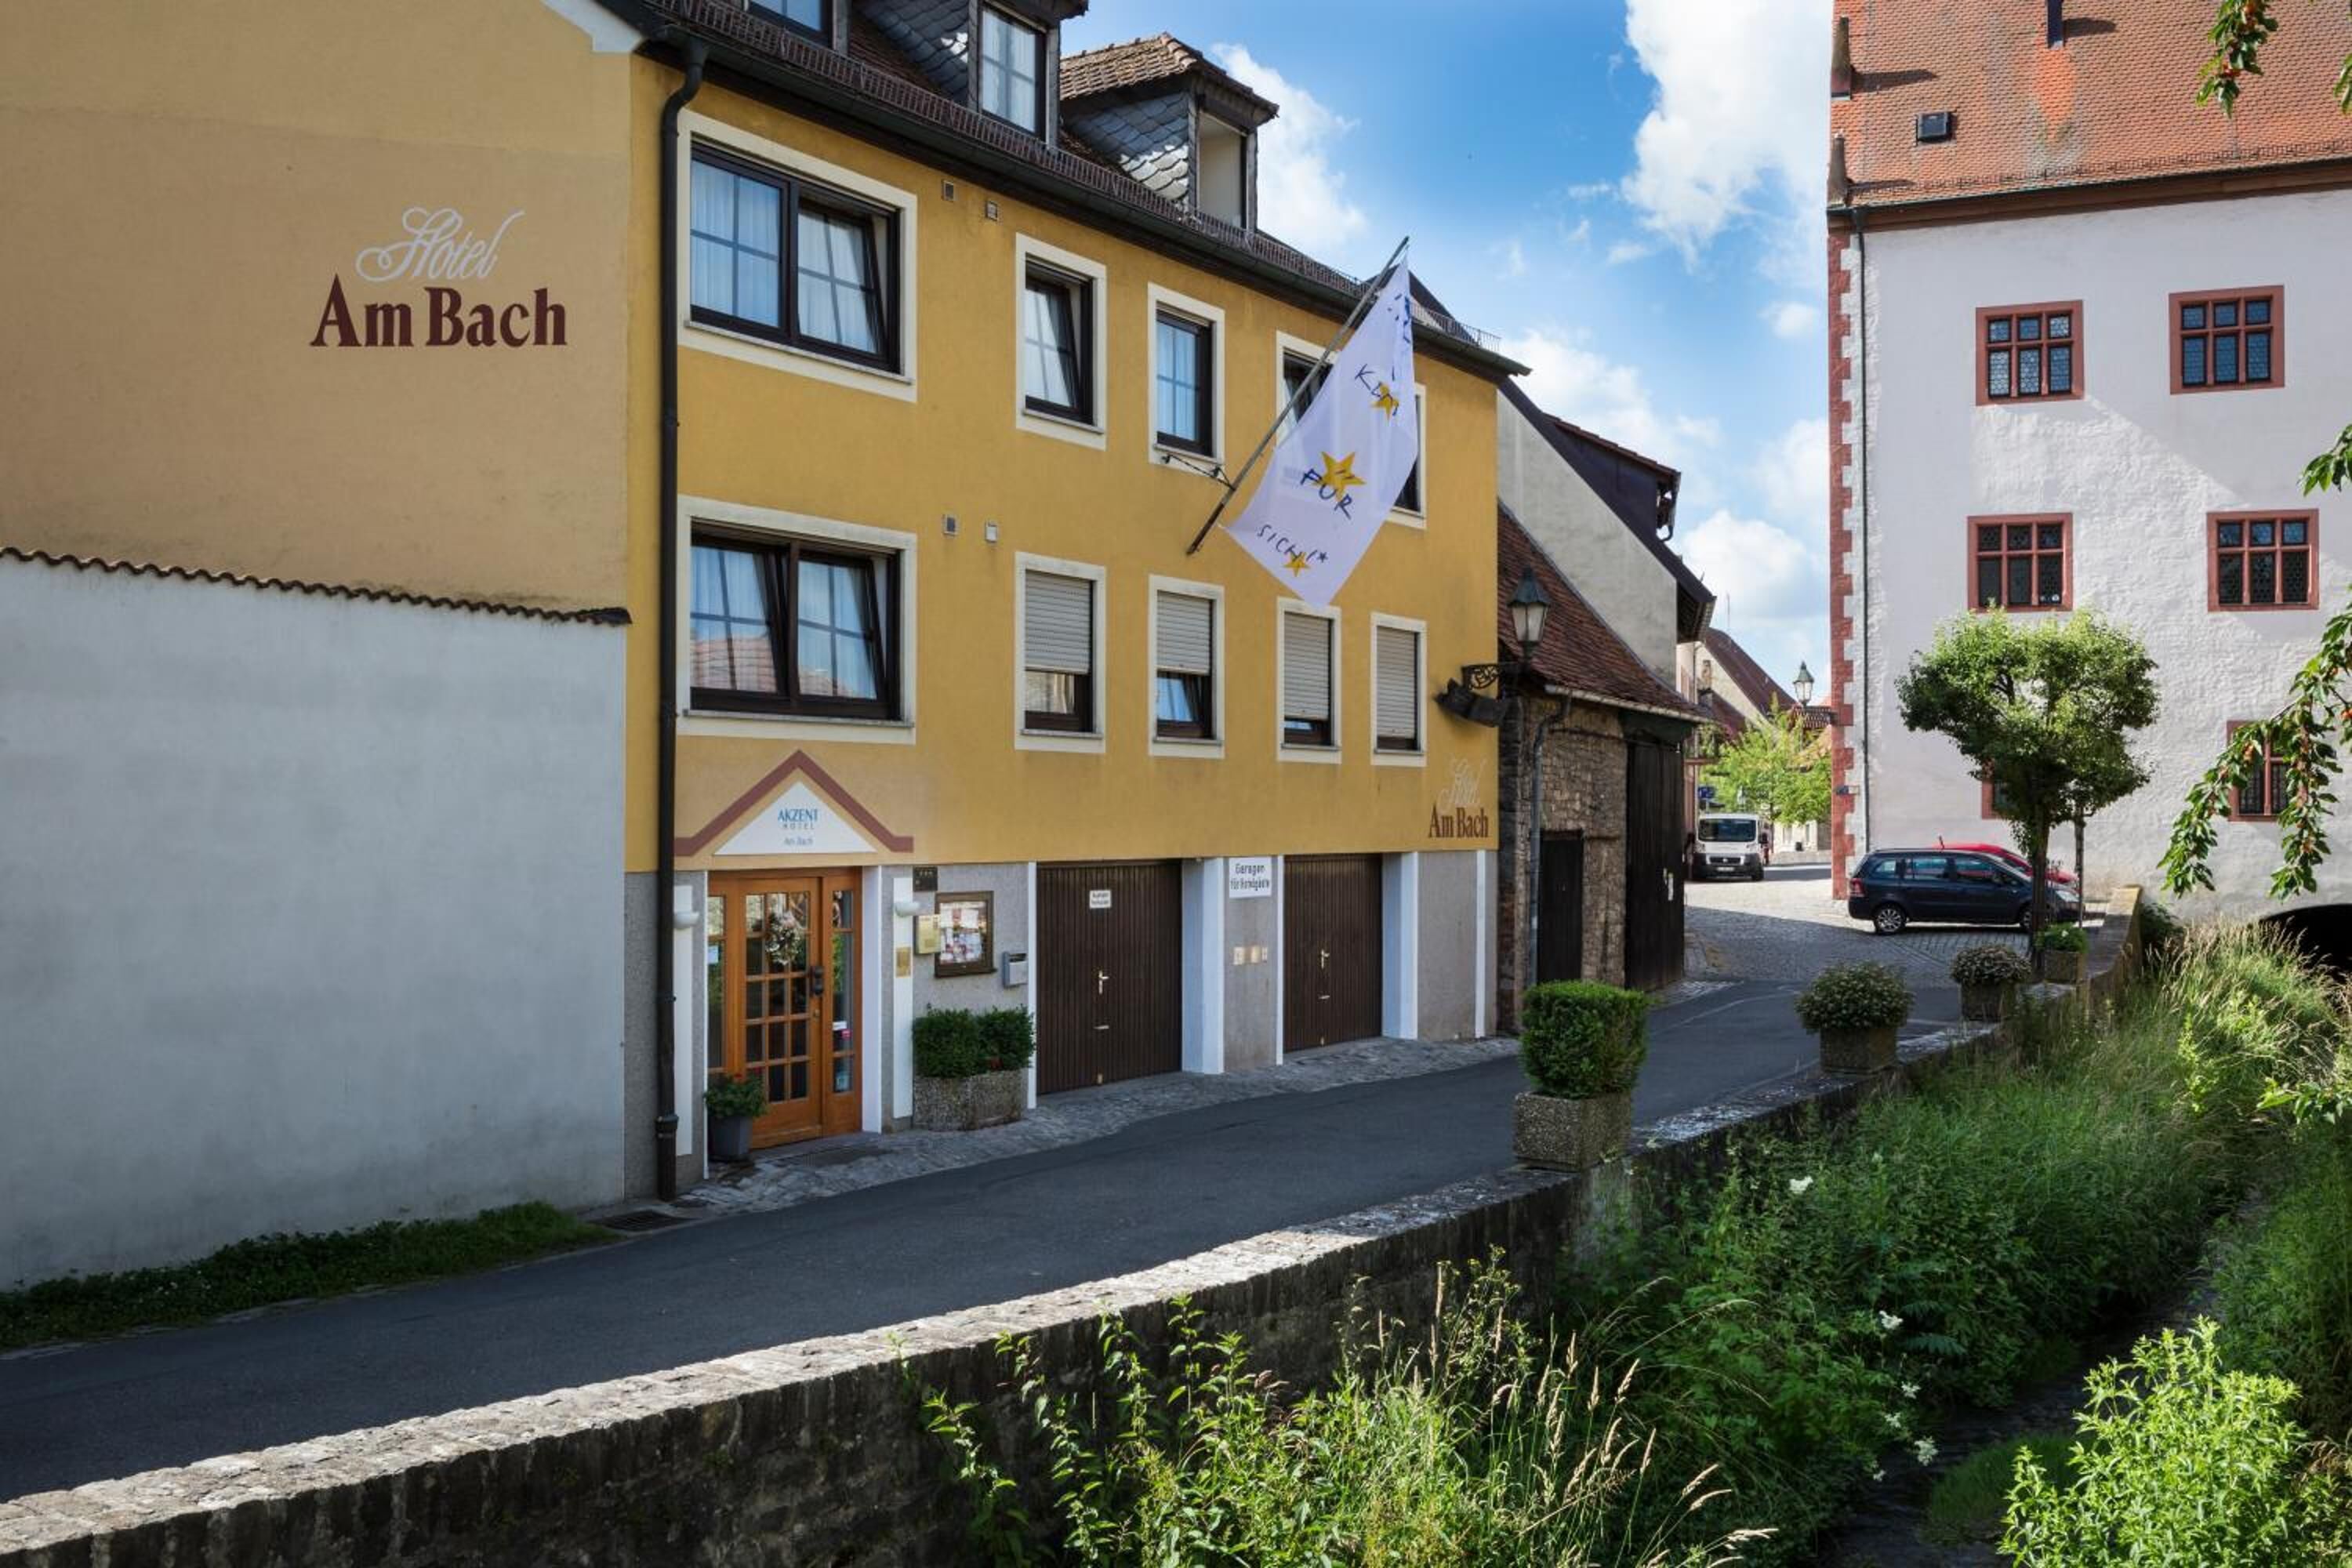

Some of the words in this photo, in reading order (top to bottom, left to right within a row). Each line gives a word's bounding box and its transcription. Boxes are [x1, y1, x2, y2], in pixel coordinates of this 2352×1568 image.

[355, 207, 524, 282] Hotel
[310, 273, 414, 347] Am
[424, 285, 568, 347] Bach
[778, 808, 818, 822] AKZENT
[1428, 800, 1454, 838] Am
[1456, 806, 1489, 838] Bach
[1235, 863, 1265, 876] Garagen
